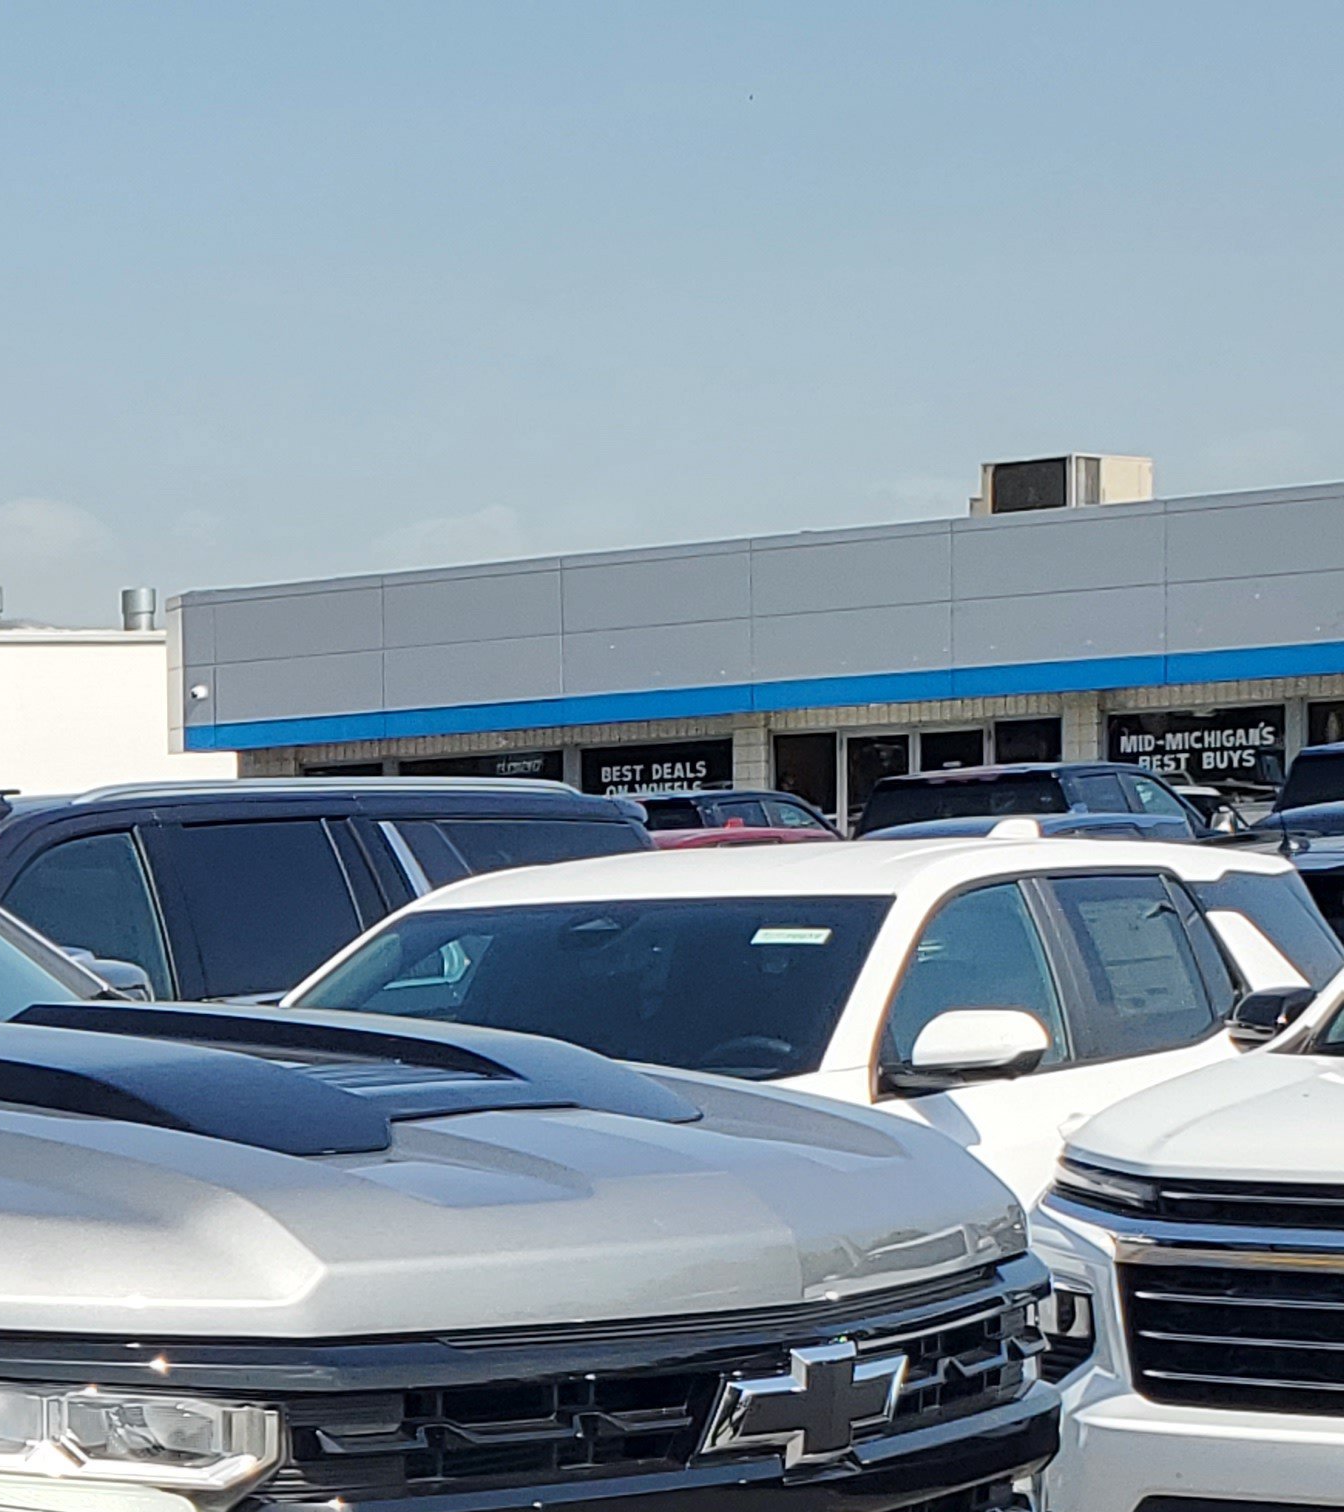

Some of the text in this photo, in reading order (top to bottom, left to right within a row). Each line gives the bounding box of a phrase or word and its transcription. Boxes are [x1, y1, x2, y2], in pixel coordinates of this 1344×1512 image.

[1120, 722, 1276, 753] MID-MICHIGAN'S
[601, 761, 707, 782] BEST DEALS
[1138, 749, 1256, 772] BEST BUYS
